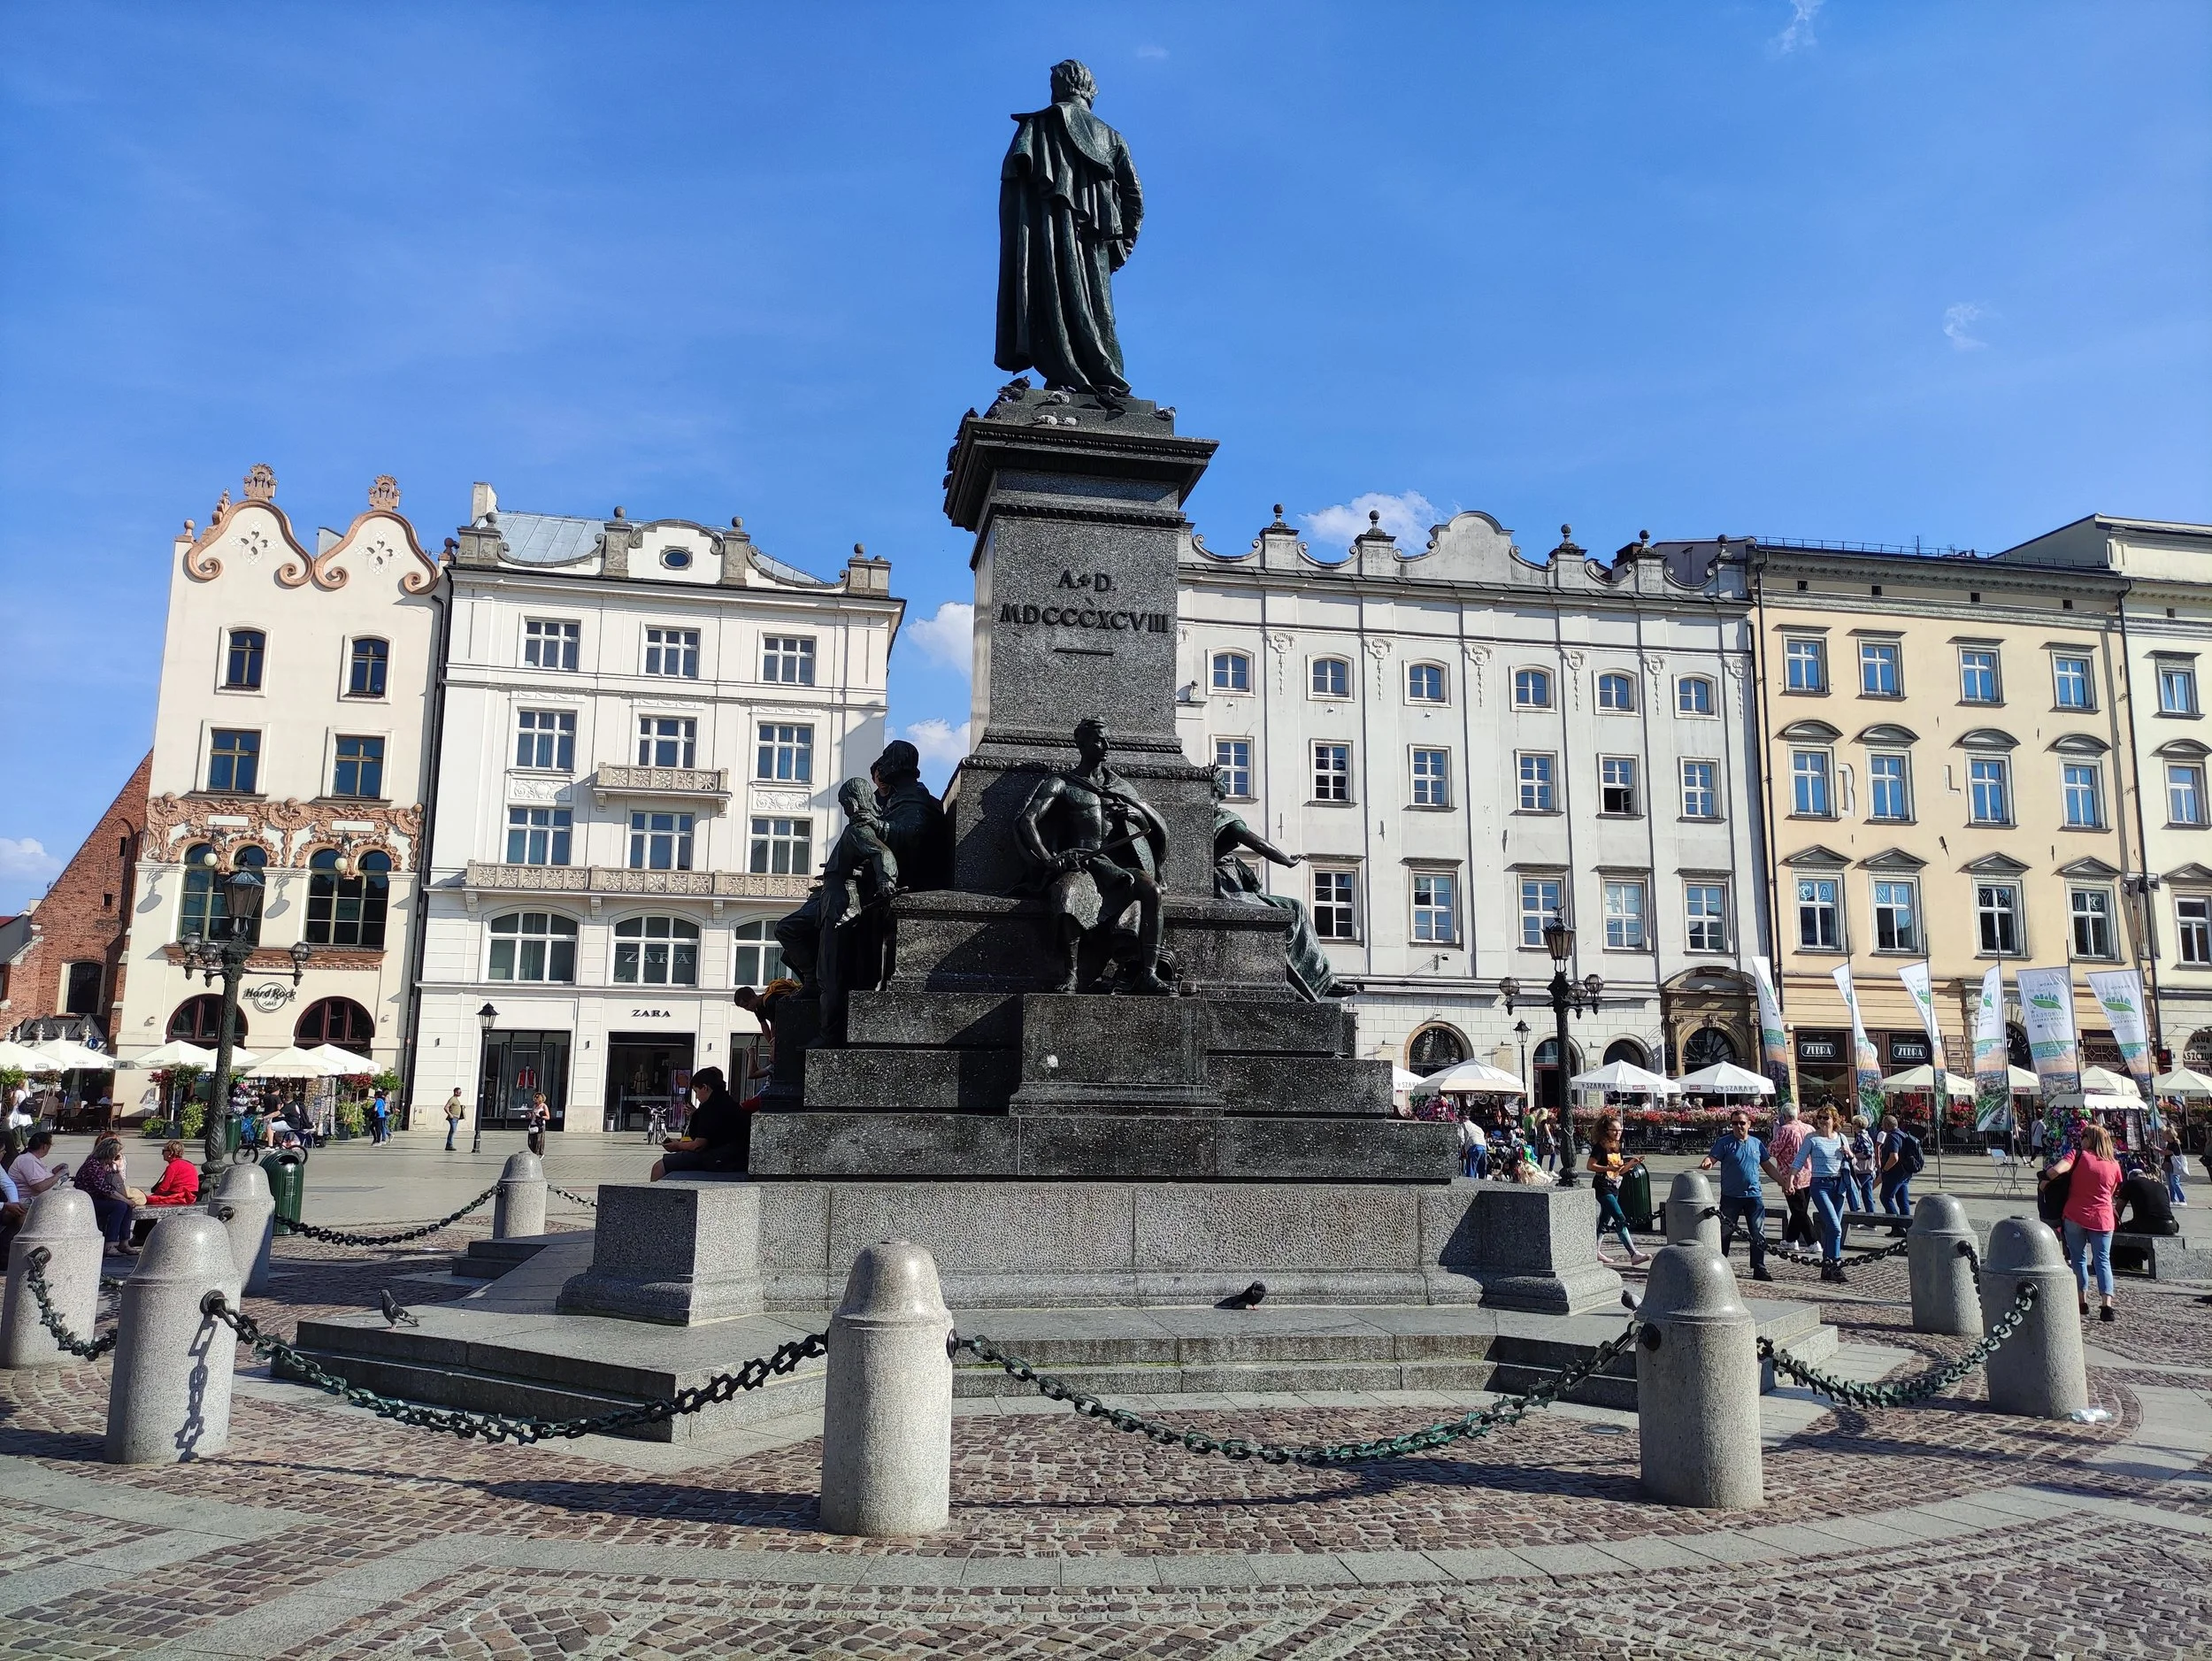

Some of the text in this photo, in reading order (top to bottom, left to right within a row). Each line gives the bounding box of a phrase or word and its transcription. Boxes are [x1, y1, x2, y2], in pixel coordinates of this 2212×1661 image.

[1000, 604, 1169, 633] MDCCCXCVIII
[625, 952, 691, 965] ZARA
[244, 988, 296, 1000] Hard Rock
[1806, 1045, 1832, 1055] ZEBRA
[1898, 1047, 1923, 1057] ZEBRA
